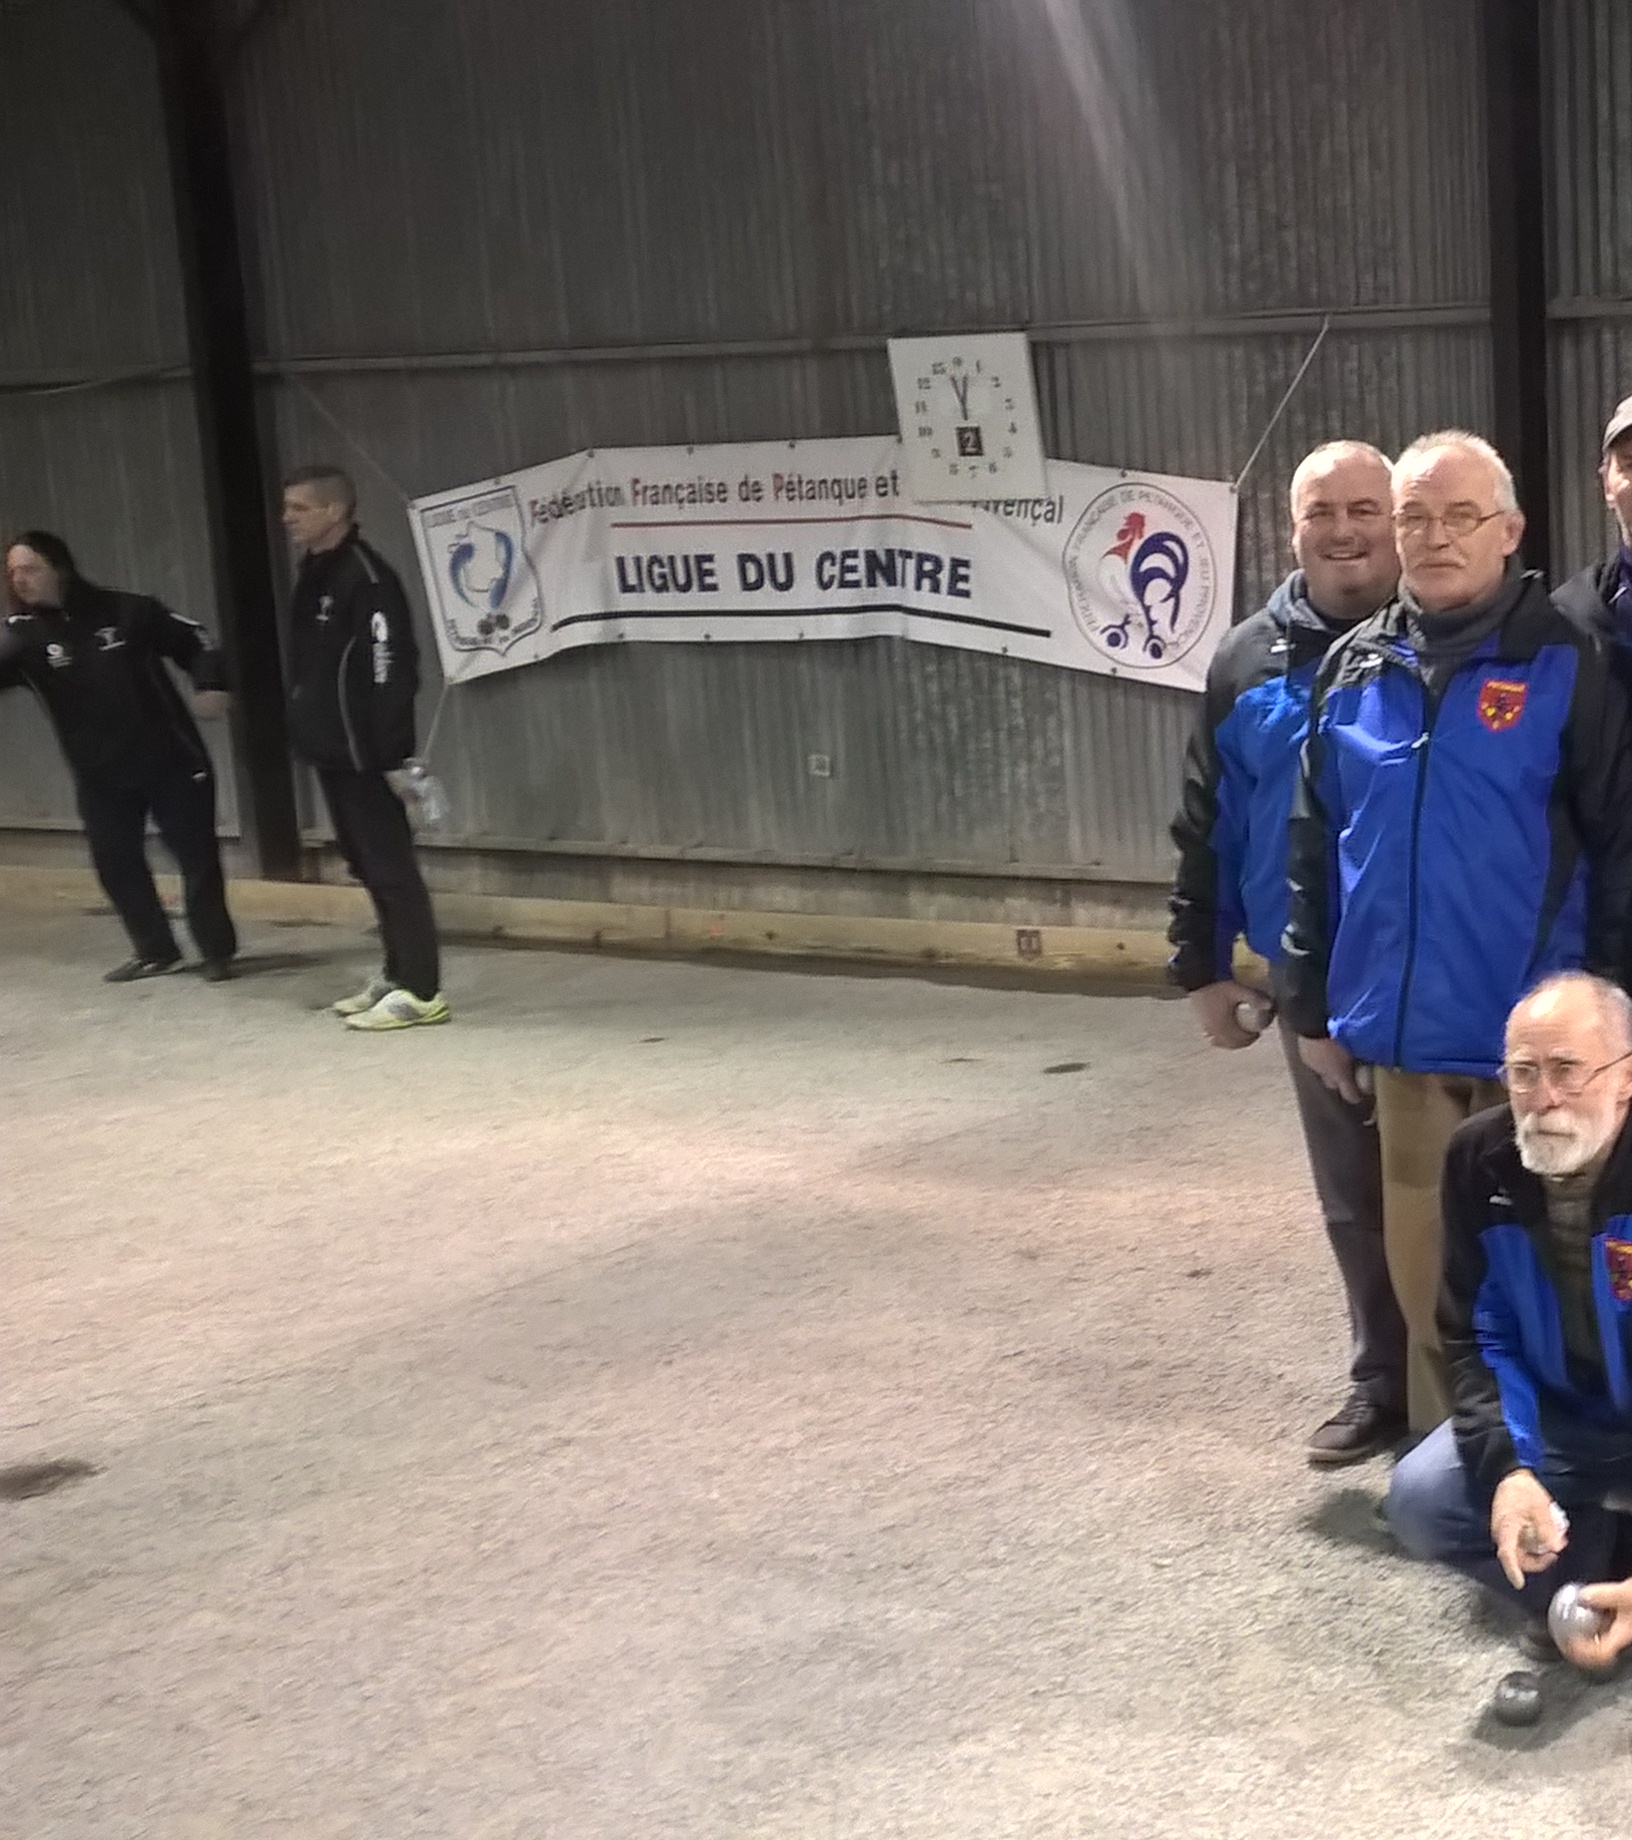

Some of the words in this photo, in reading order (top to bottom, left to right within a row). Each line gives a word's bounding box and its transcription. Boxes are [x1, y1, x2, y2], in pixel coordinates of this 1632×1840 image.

[965, 431, 976, 453] 2
[630, 476, 728, 510] Française
[737, 474, 764, 502] de
[771, 471, 868, 506] Pétanque
[875, 470, 900, 497] et
[616, 553, 720, 594] LIGUE
[736, 551, 795, 592] DU
[815, 549, 972, 599] CENTRE
